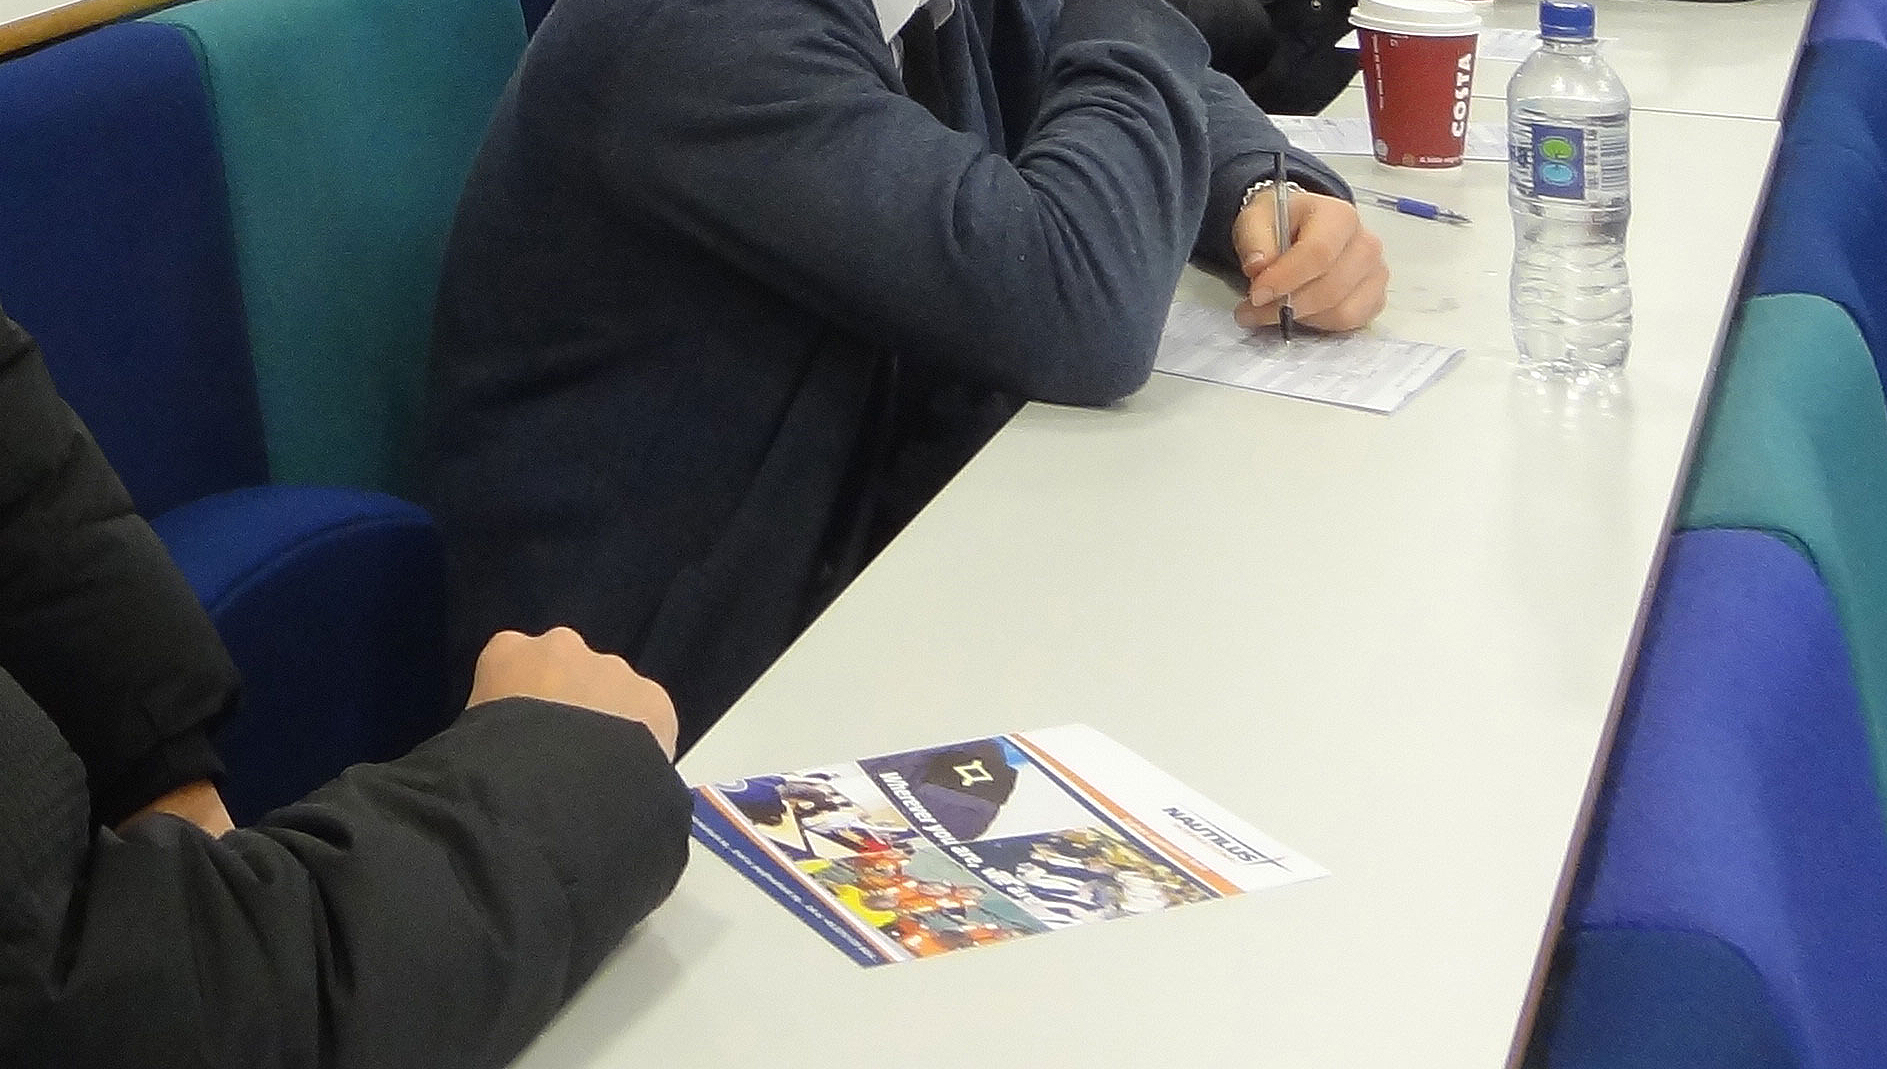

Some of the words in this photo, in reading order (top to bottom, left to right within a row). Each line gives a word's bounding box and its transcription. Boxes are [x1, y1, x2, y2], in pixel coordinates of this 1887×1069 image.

[1451, 53, 1473, 138] COSTA
[878, 770, 937, 824] Wherever
[922, 822, 962, 845] you
[1162, 806, 1260, 862] NAUTILUS
